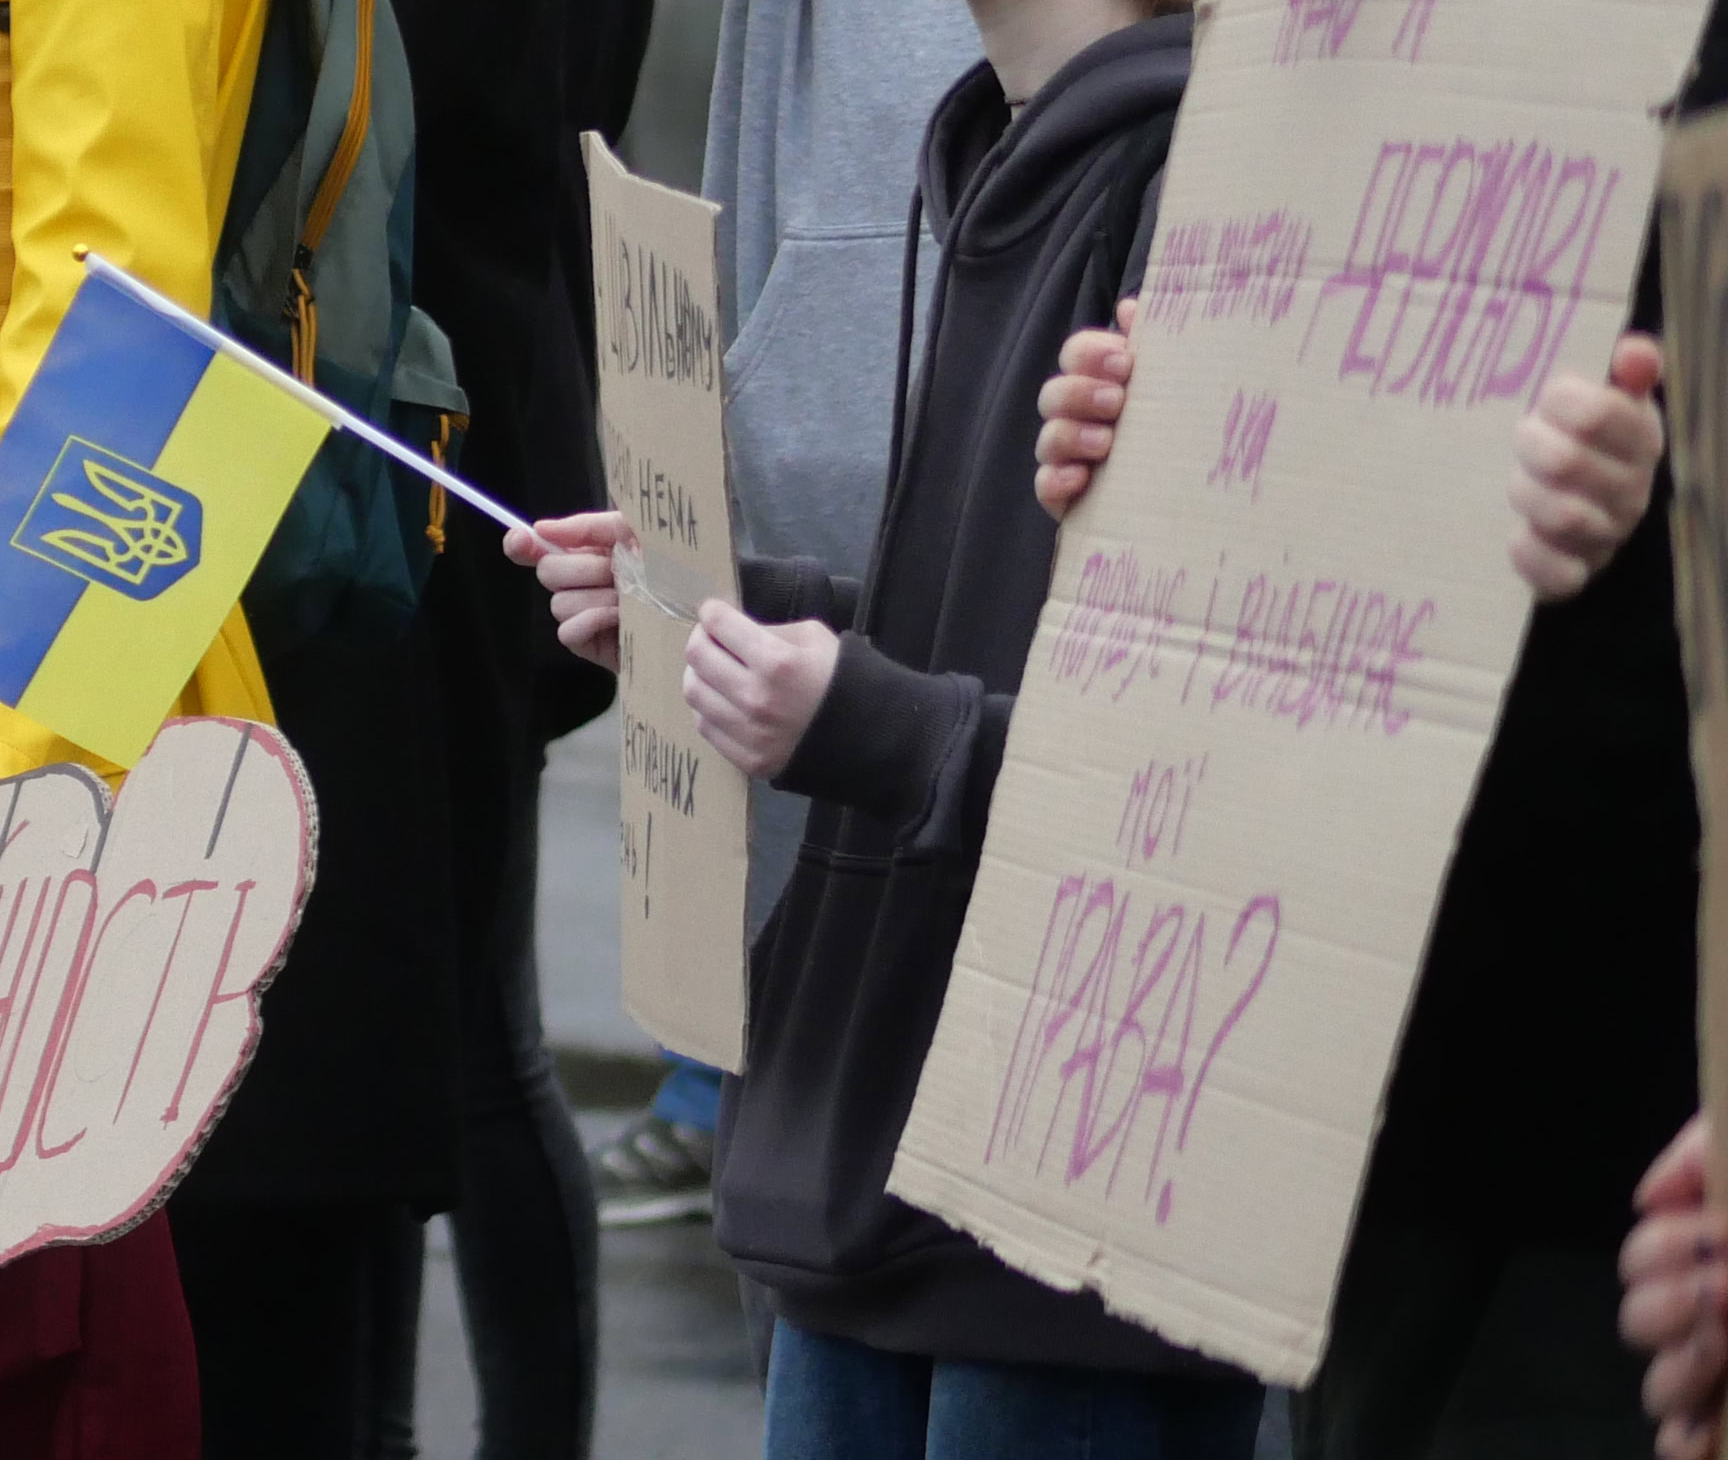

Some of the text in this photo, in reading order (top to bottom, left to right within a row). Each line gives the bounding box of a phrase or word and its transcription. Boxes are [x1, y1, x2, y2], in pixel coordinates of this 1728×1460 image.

[637, 456, 699, 552] НЕМА
[1115, 751, 1209, 869] МОЇ
[984, 871, 1282, 1226] ПРАВА?
